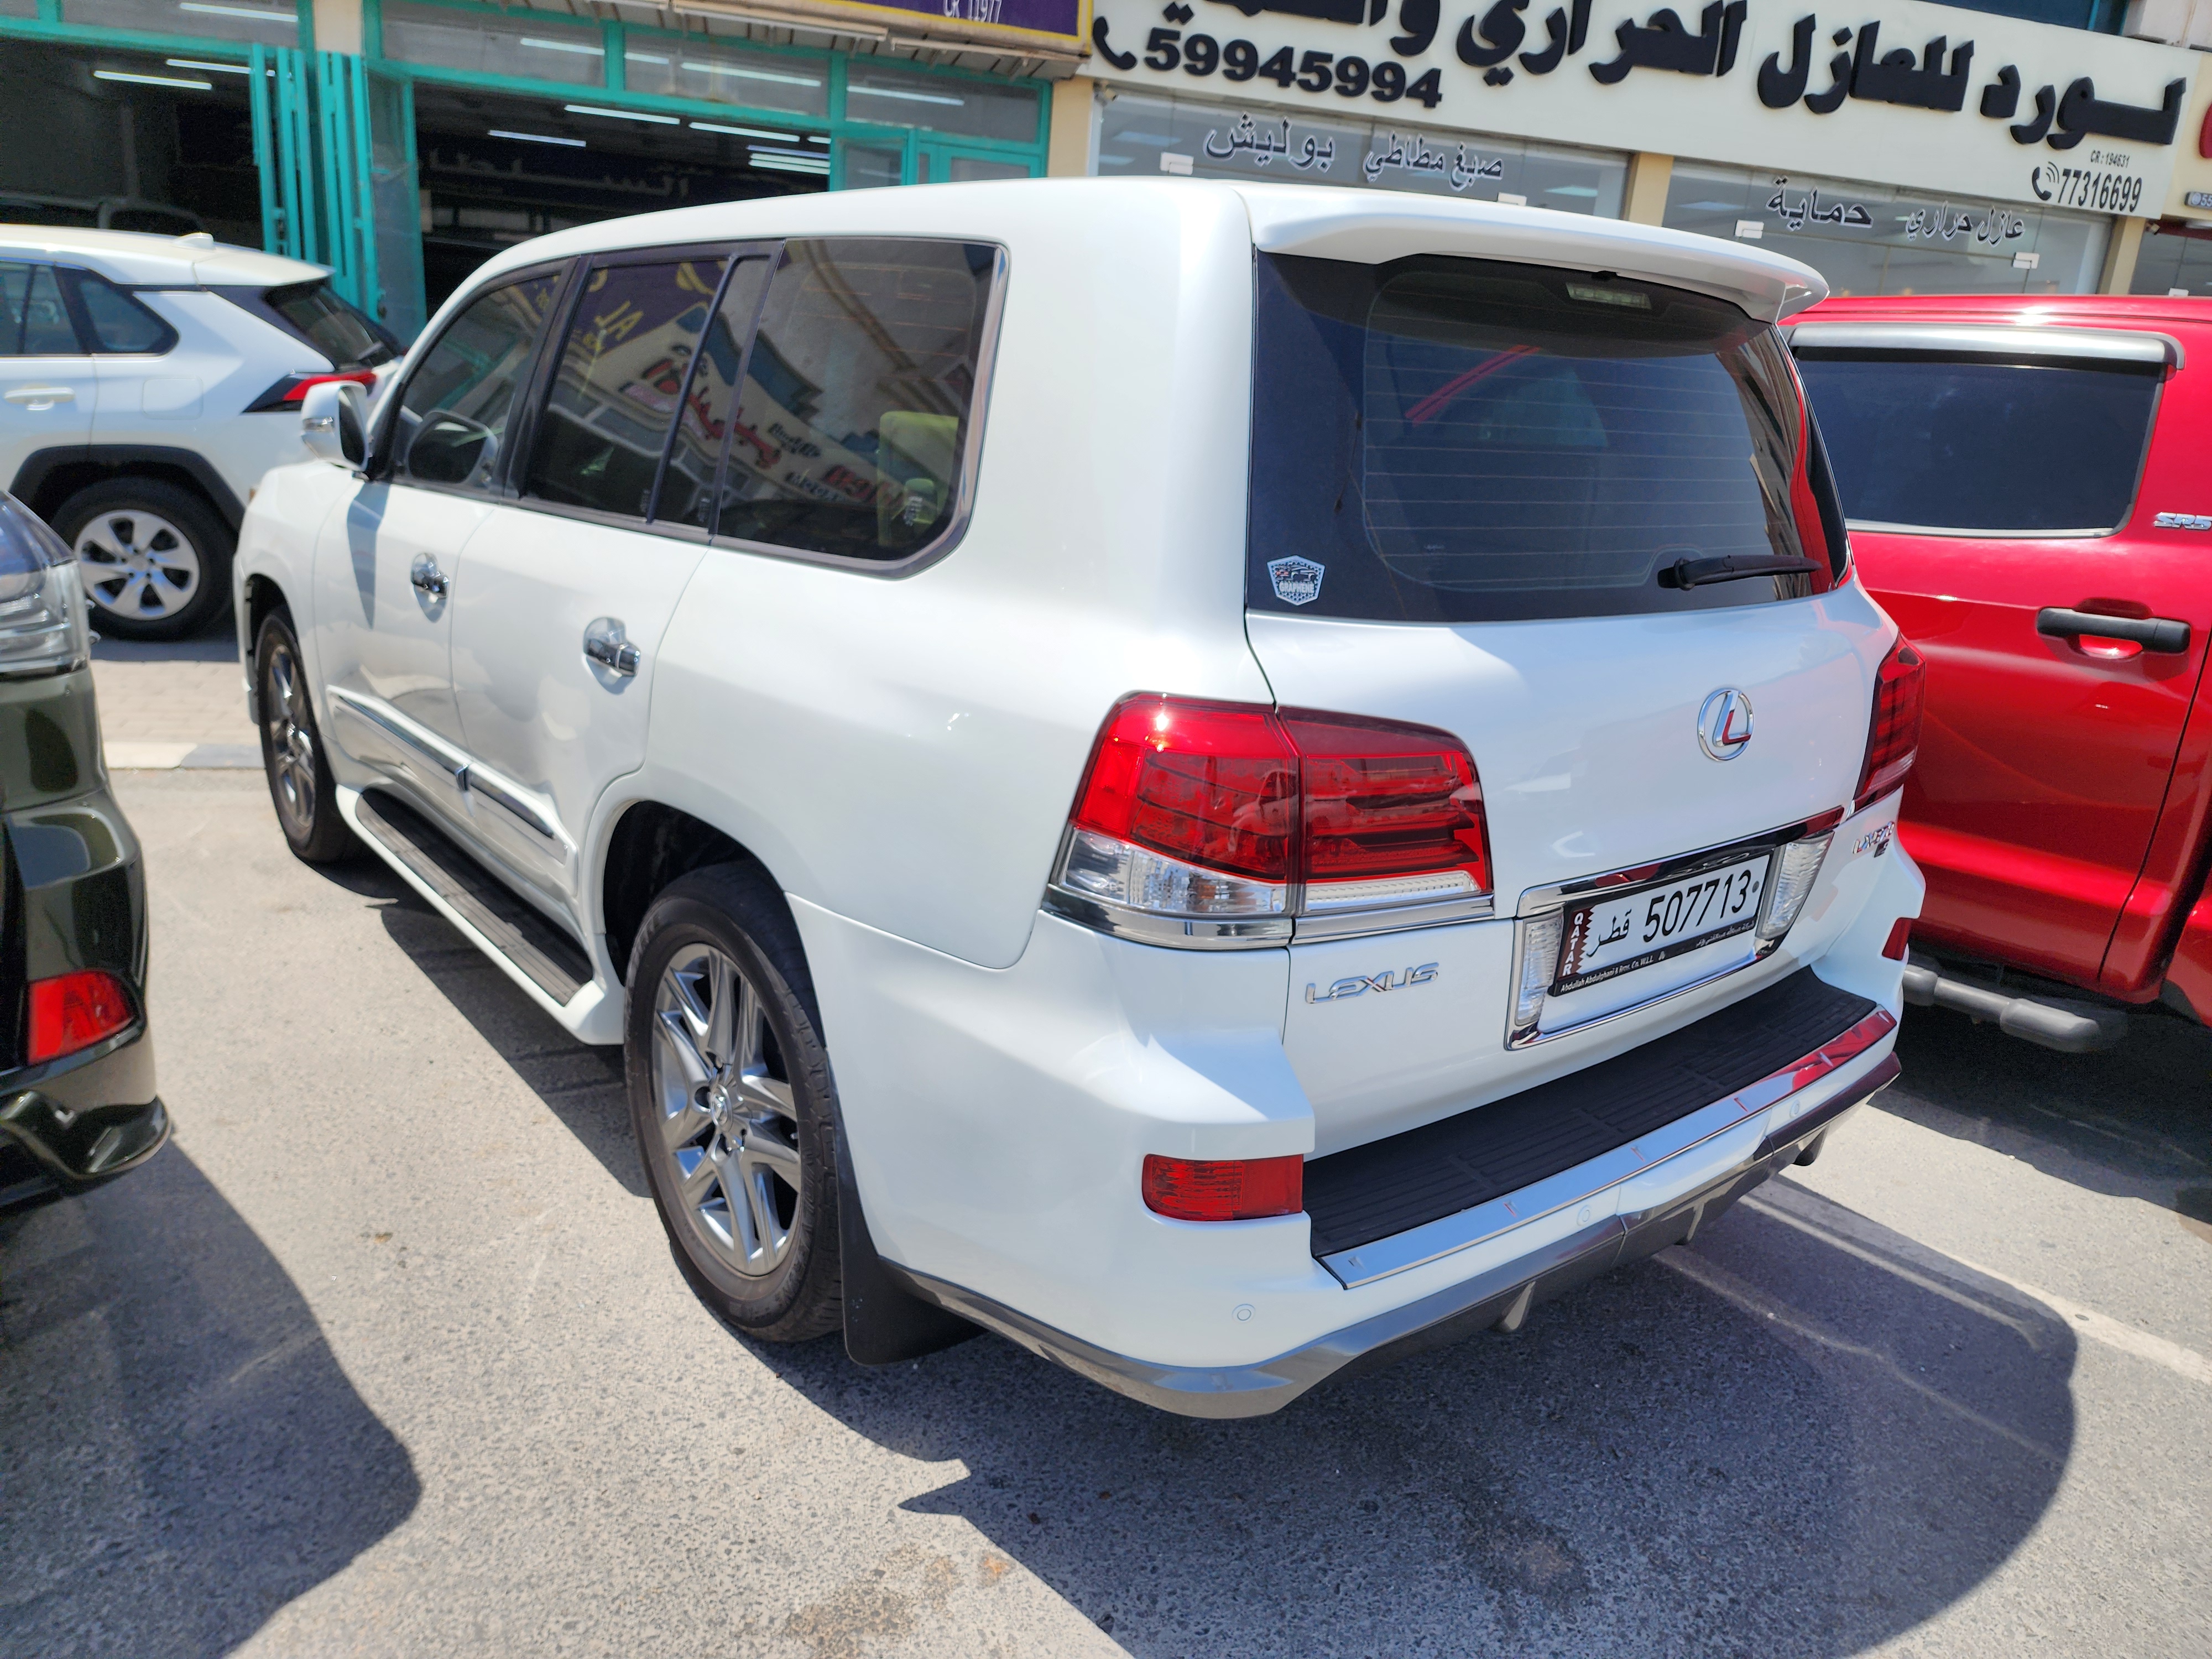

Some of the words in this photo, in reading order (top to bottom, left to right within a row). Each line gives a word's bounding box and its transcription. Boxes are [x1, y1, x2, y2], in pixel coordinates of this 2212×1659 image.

[1145, 27, 1442, 108] 59945994
[1757, 13, 1974, 114] للعازل
[1980, 64, 2187, 150] لورد
[1203, 112, 1336, 173] بوليش
[1363, 130, 1446, 182] مطاطي
[1448, 140, 1505, 191] صبغ
[1765, 175, 1874, 231] حماية
[2058, 168, 2142, 213] 77316699
[1905, 200, 1973, 242] حراري
[1976, 206, 2026, 247] عازل
[1279, 581, 1314, 593] GRAPHENE
[1643, 869, 1751, 942] 507713
[1563, 912, 1584, 977] QATAR
[1586, 909, 1632, 958] قطر
[1305, 962, 1439, 1004] LEXUS
[1561, 978, 1585, 993] Abdullah
